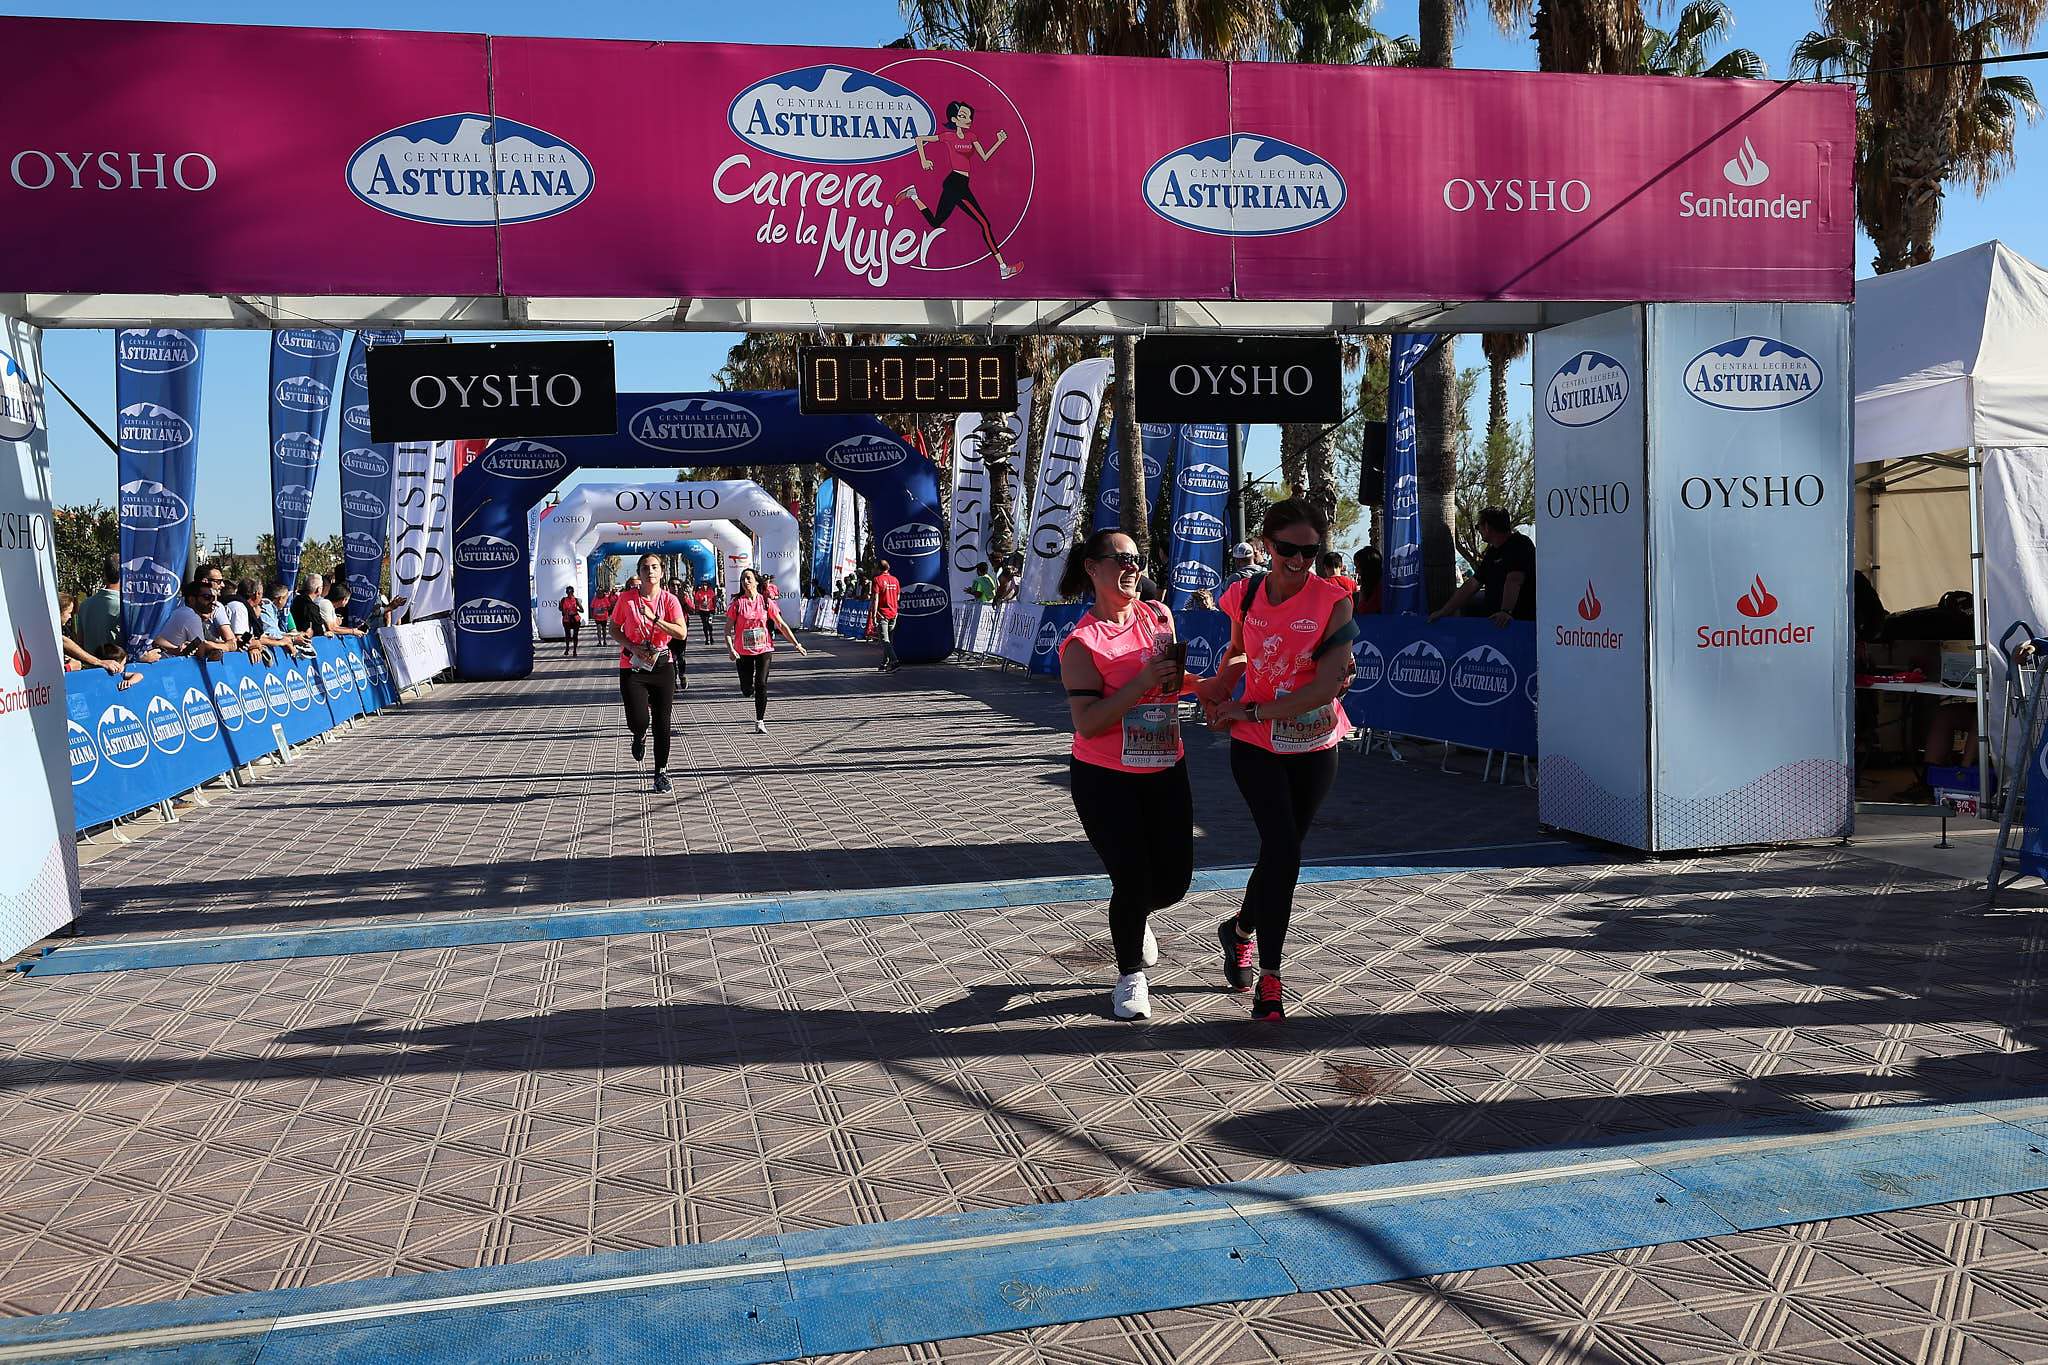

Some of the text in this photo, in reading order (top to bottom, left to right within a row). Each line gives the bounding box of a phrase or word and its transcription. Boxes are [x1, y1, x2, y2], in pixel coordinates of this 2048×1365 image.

[777, 97, 913, 110] CENTRAL LECHERA
[745, 98, 919, 140] ASTURIANA
[404, 152, 481, 163] CENTRAL
[11, 150, 217, 192] OYSHO
[366, 153, 576, 197] ASTURIANA
[712, 154, 883, 208] Carrera
[1190, 168, 1324, 180] CENTRAL LECHERA
[1159, 169, 1332, 209] ASTURIANA
[1443, 178, 1591, 213] OYSHO
[1679, 191, 1812, 219] Santander
[757, 204, 947, 287] de la Mujer
[282, 333, 336, 352] ASTURIANA
[1590, 371, 1620, 384] LECHERA
[1694, 364, 1812, 393] ASTURIANA
[1715, 361, 1808, 371] CENTRAL LECHERA
[410, 373, 581, 409] OYSHO
[815, 358, 1000, 401] 01:02:38
[1169, 364, 1313, 396] OYSHO
[1550, 383, 1622, 413] ASTURIANA
[640, 416, 752, 439] ASTURIANA
[659, 414, 702, 422] CENTRAL
[487, 456, 560, 470] ASTURIANA
[833, 449, 902, 465] ASTURIANA
[1032, 390, 1092, 559] OYSHO
[616, 489, 719, 512] OYSHO
[1547, 481, 1630, 518] OYSHO
[1681, 474, 1824, 510] OYSHO
[553, 516, 585, 524] OYSHO
[458, 548, 515, 562] ASTURIANA
[887, 536, 940, 550] ASTURIANA
[899, 596, 947, 610] STURIANA
[459, 611, 516, 625] ASTURIANA
[1556, 624, 1624, 650] Santander
[1696, 622, 1815, 648] Santander
[1391, 661, 1440, 685] ASTURIANA
[1453, 665, 1508, 693] ASTURIANA
[0, 681, 52, 715] Santander
[104, 730, 148, 757] ASTURIANA
